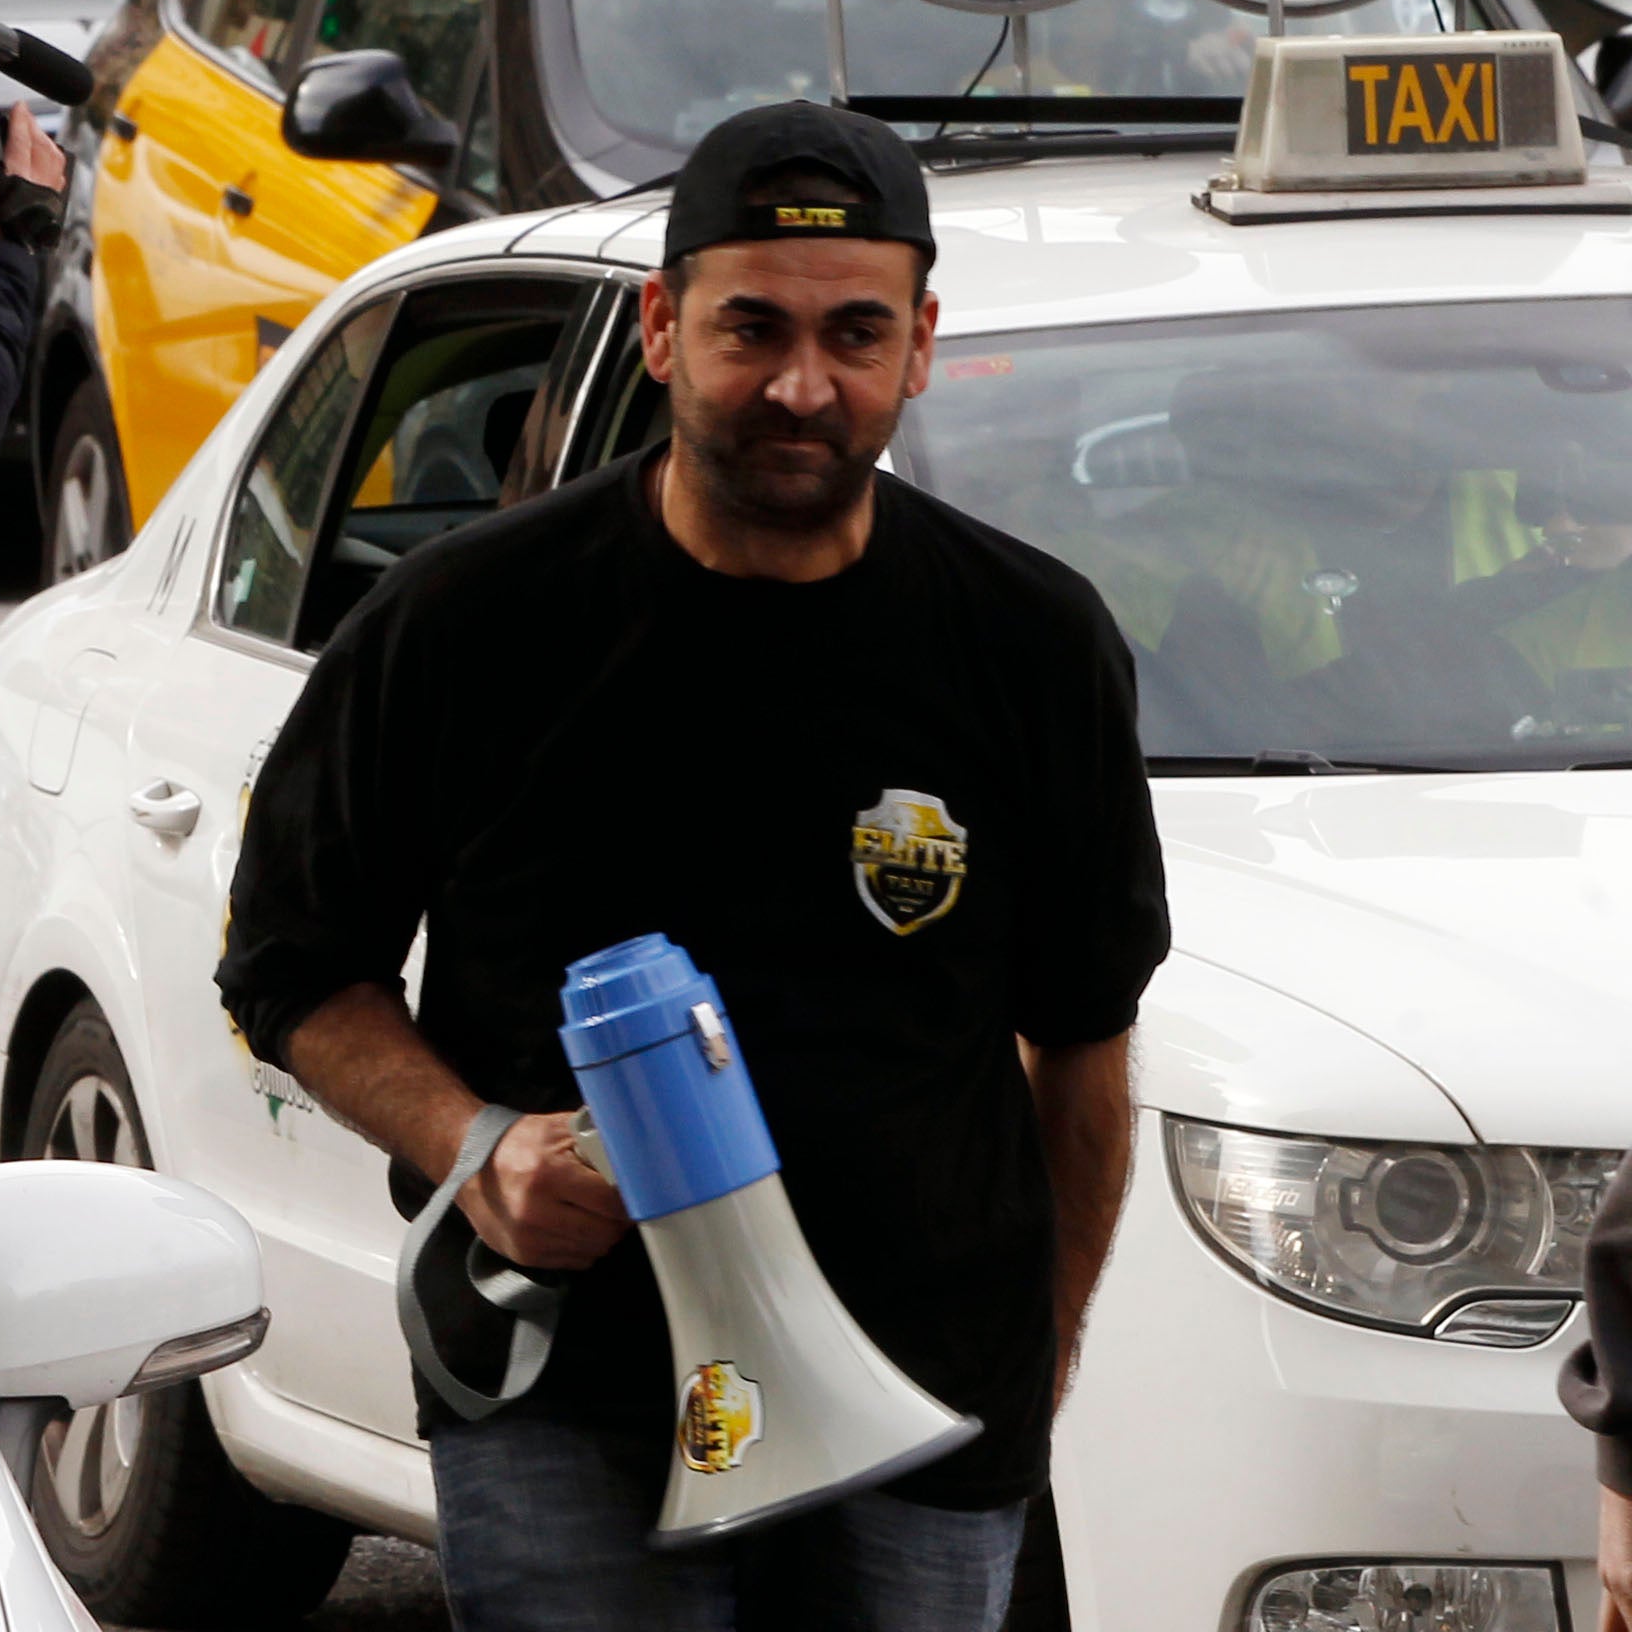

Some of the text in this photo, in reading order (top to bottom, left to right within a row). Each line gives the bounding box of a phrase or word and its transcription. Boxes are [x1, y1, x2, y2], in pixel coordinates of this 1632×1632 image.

[1348, 62, 1496, 146] TAXI
[775, 207, 846, 227] ELITE
[850, 826, 968, 877] ELITE
